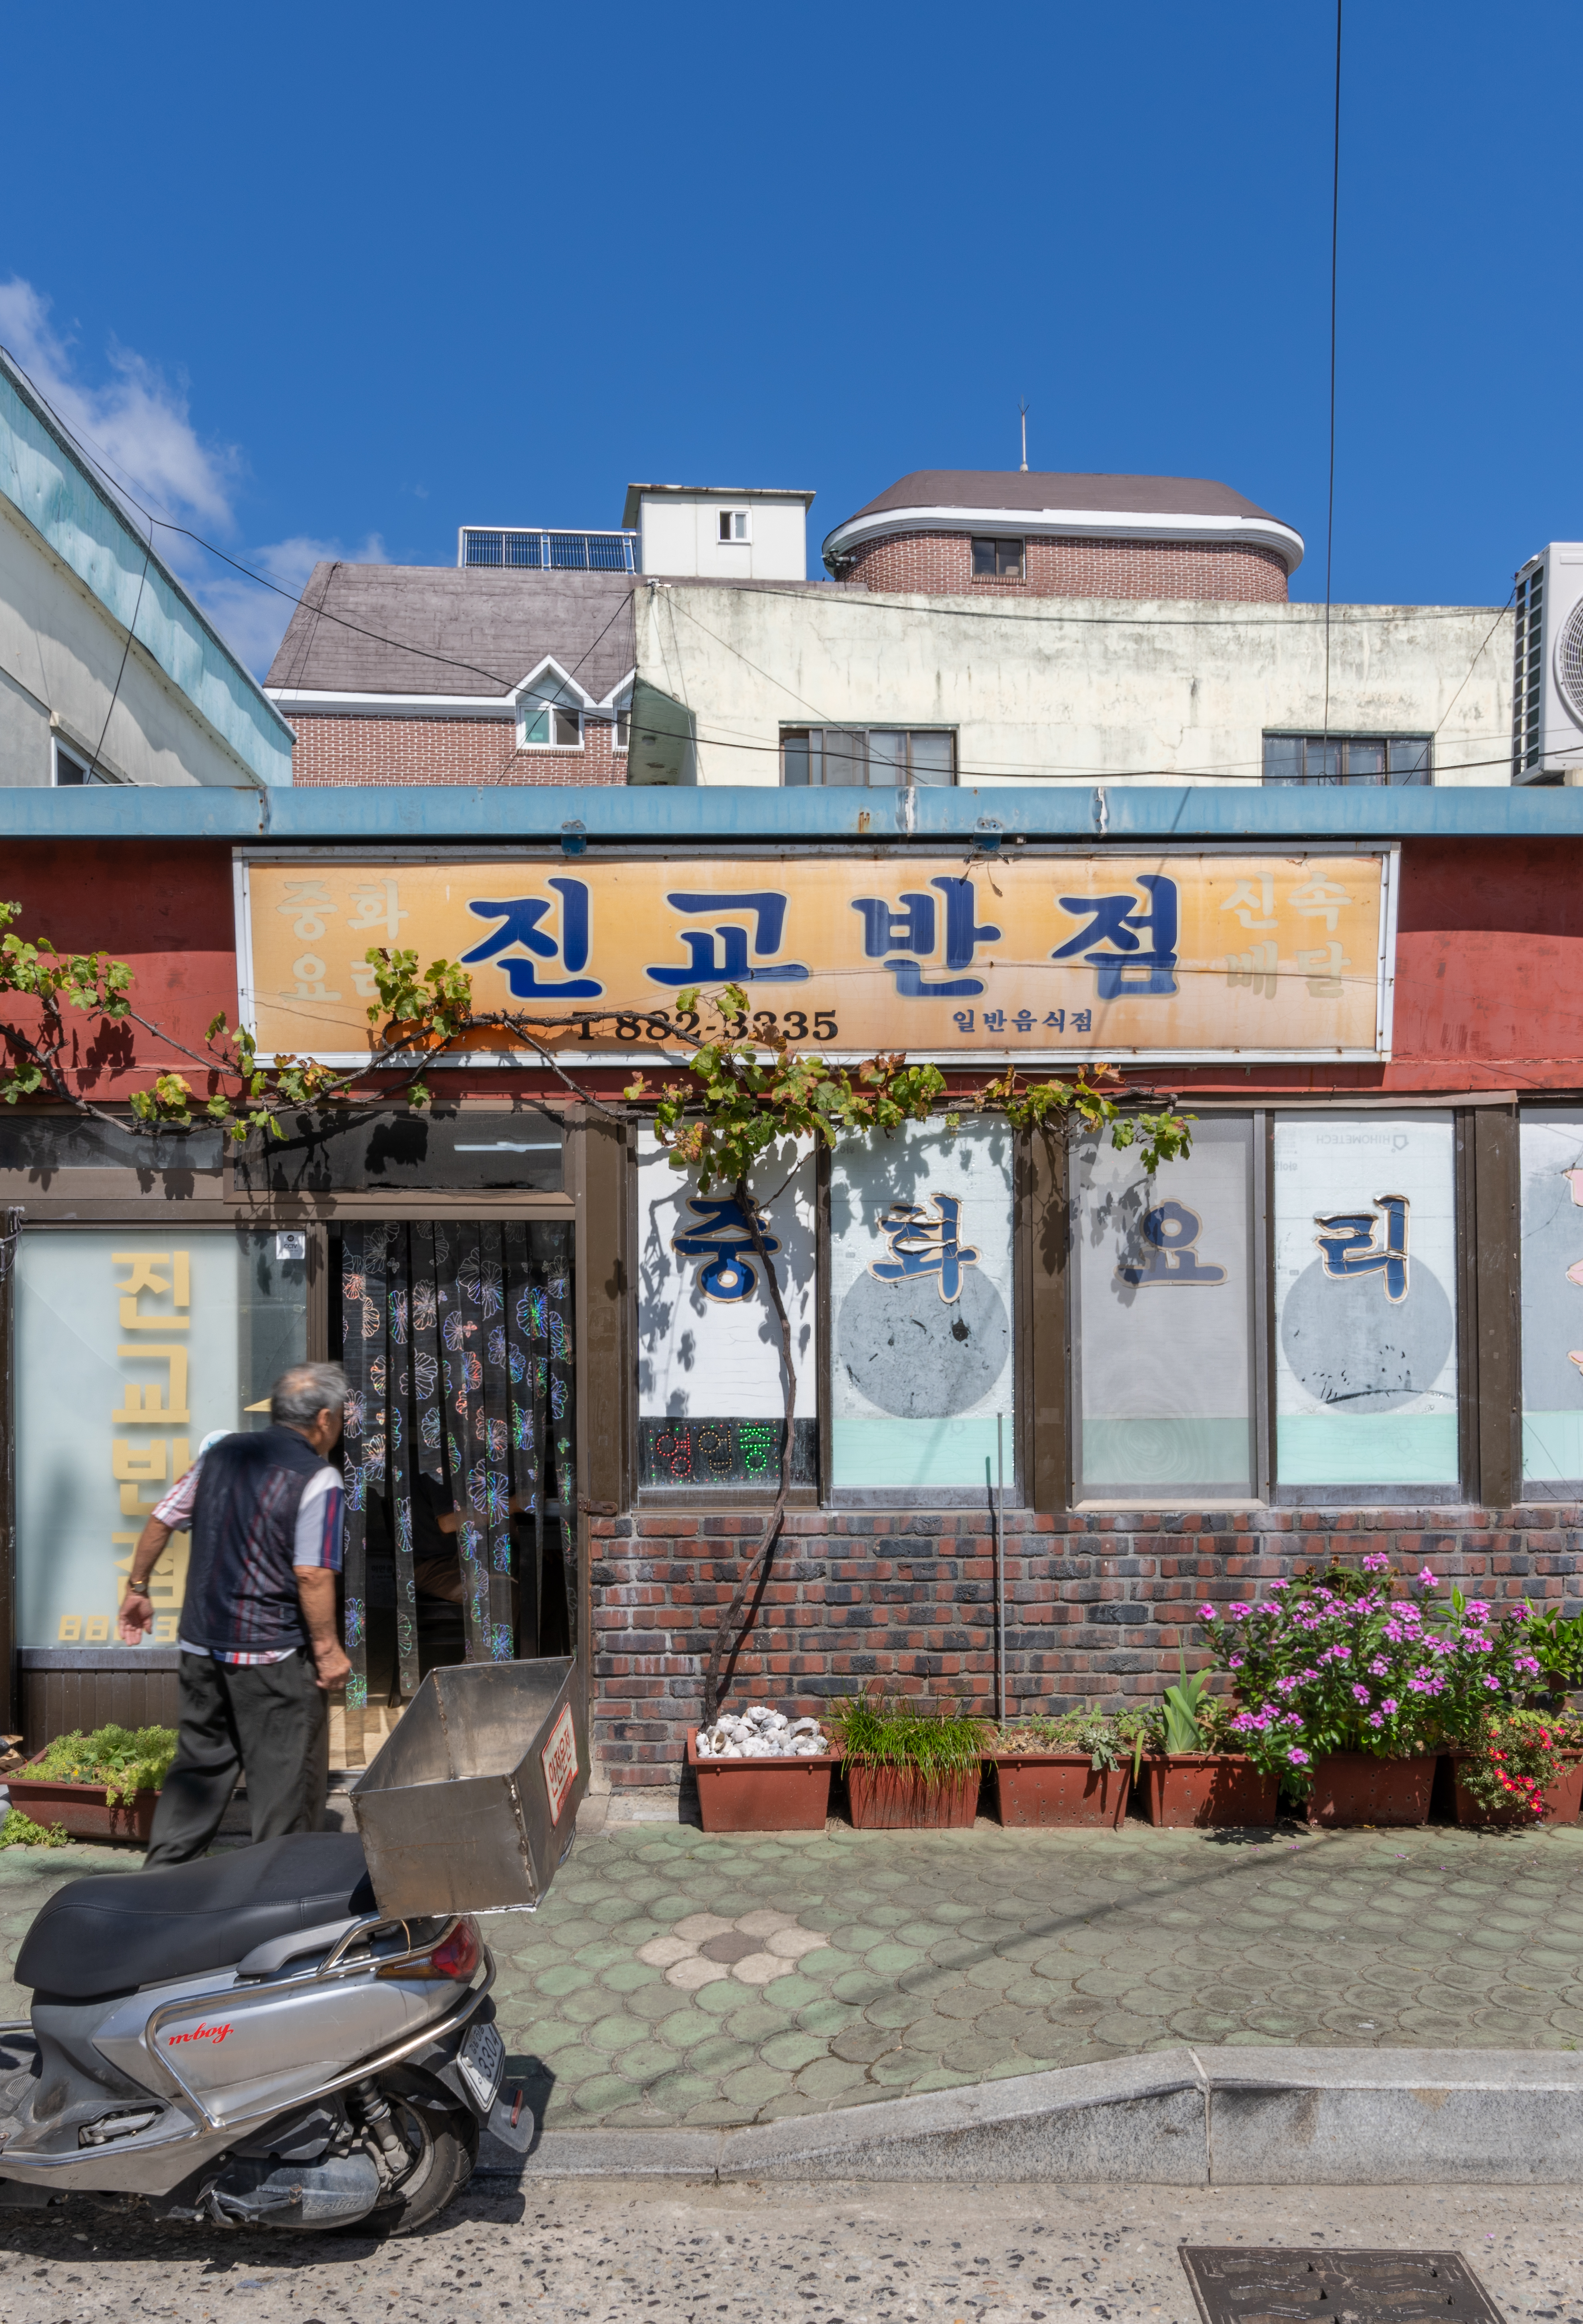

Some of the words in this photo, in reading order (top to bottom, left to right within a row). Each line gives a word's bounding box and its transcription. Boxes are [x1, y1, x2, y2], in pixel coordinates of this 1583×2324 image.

[276, 878, 409, 940] 중화
[1220, 871, 1352, 932] 신속
[457, 874, 1183, 1000] 진교반점
[1224, 940, 1352, 1000] 배달
[615, 1010, 839, 1041] 882-3335
[953, 1009, 1092, 1033] 일반음식점
[1316, 1134, 1390, 1144] HIHOMETECH
[655, 1426, 772, 1477] 영업중
[549, 1725, 572, 1798] 안전운전
[169, 2022, 234, 2046] m-boy
[478, 2025, 499, 2078] 3304
